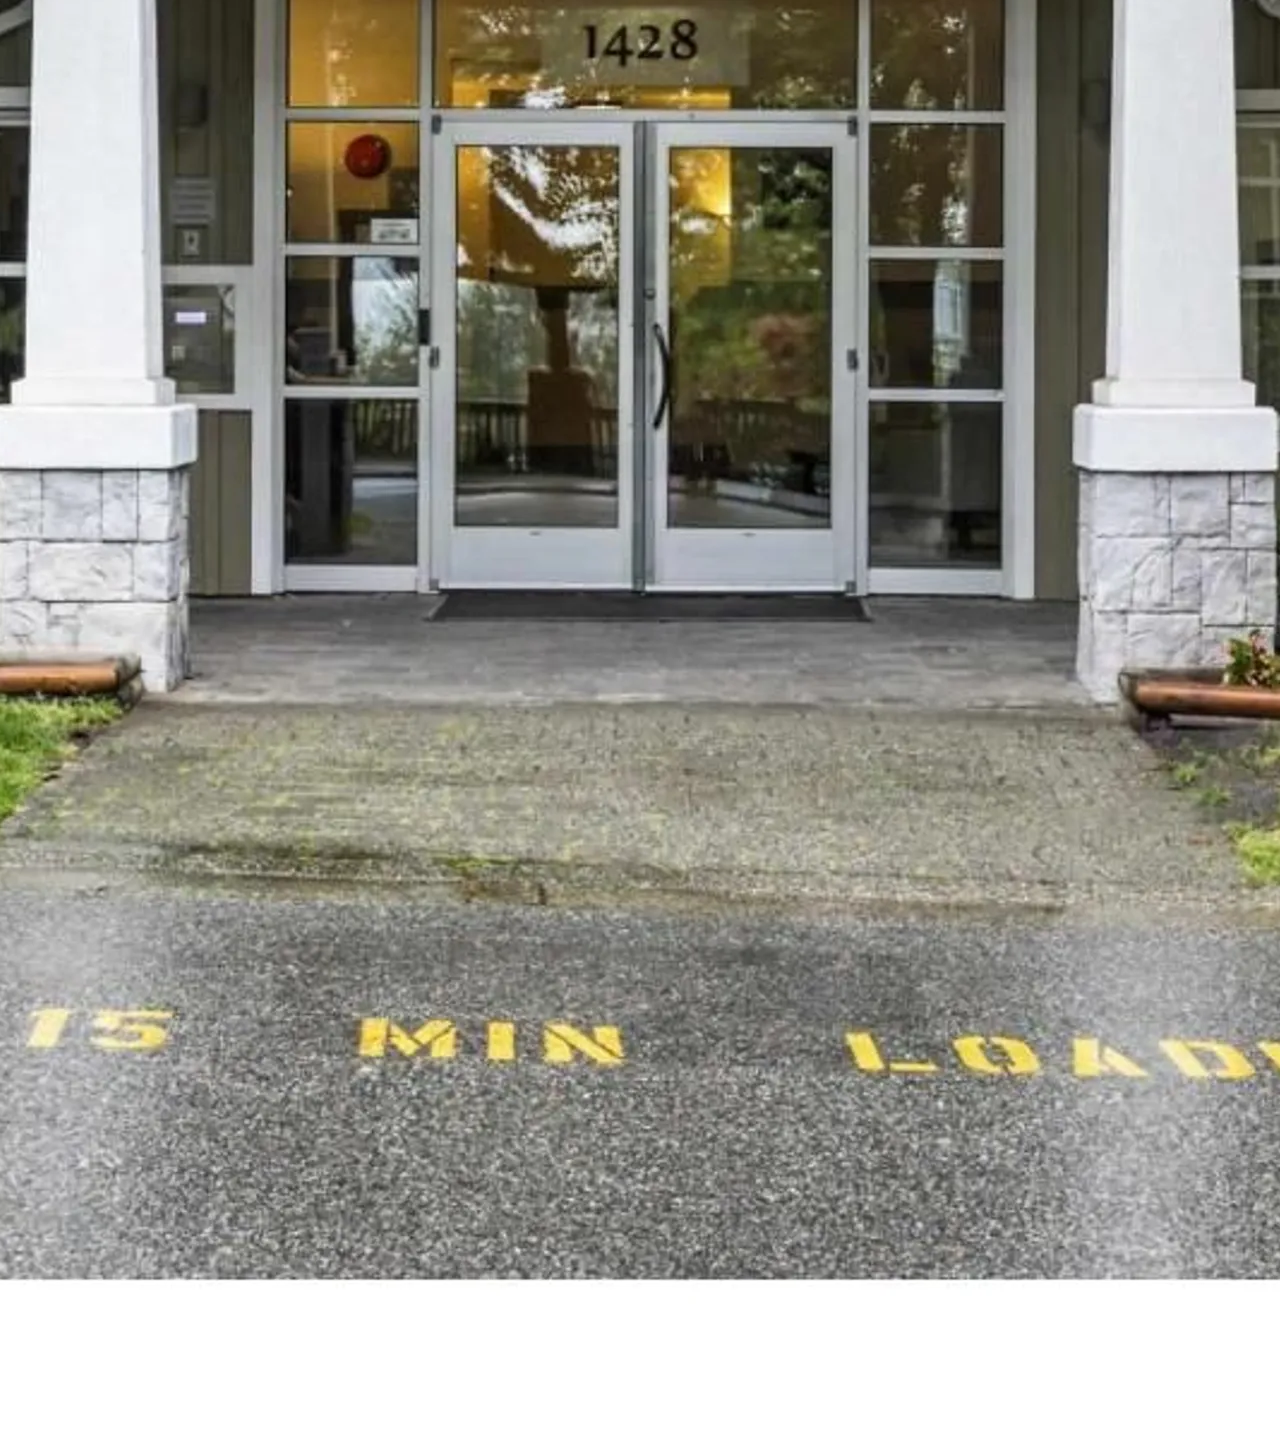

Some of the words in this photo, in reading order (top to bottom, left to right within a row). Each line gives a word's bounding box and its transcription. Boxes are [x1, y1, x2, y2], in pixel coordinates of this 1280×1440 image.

[582, 19, 699, 68] 1428
[25, 1006, 174, 1053] 15
[358, 1018, 628, 1063] MIN
